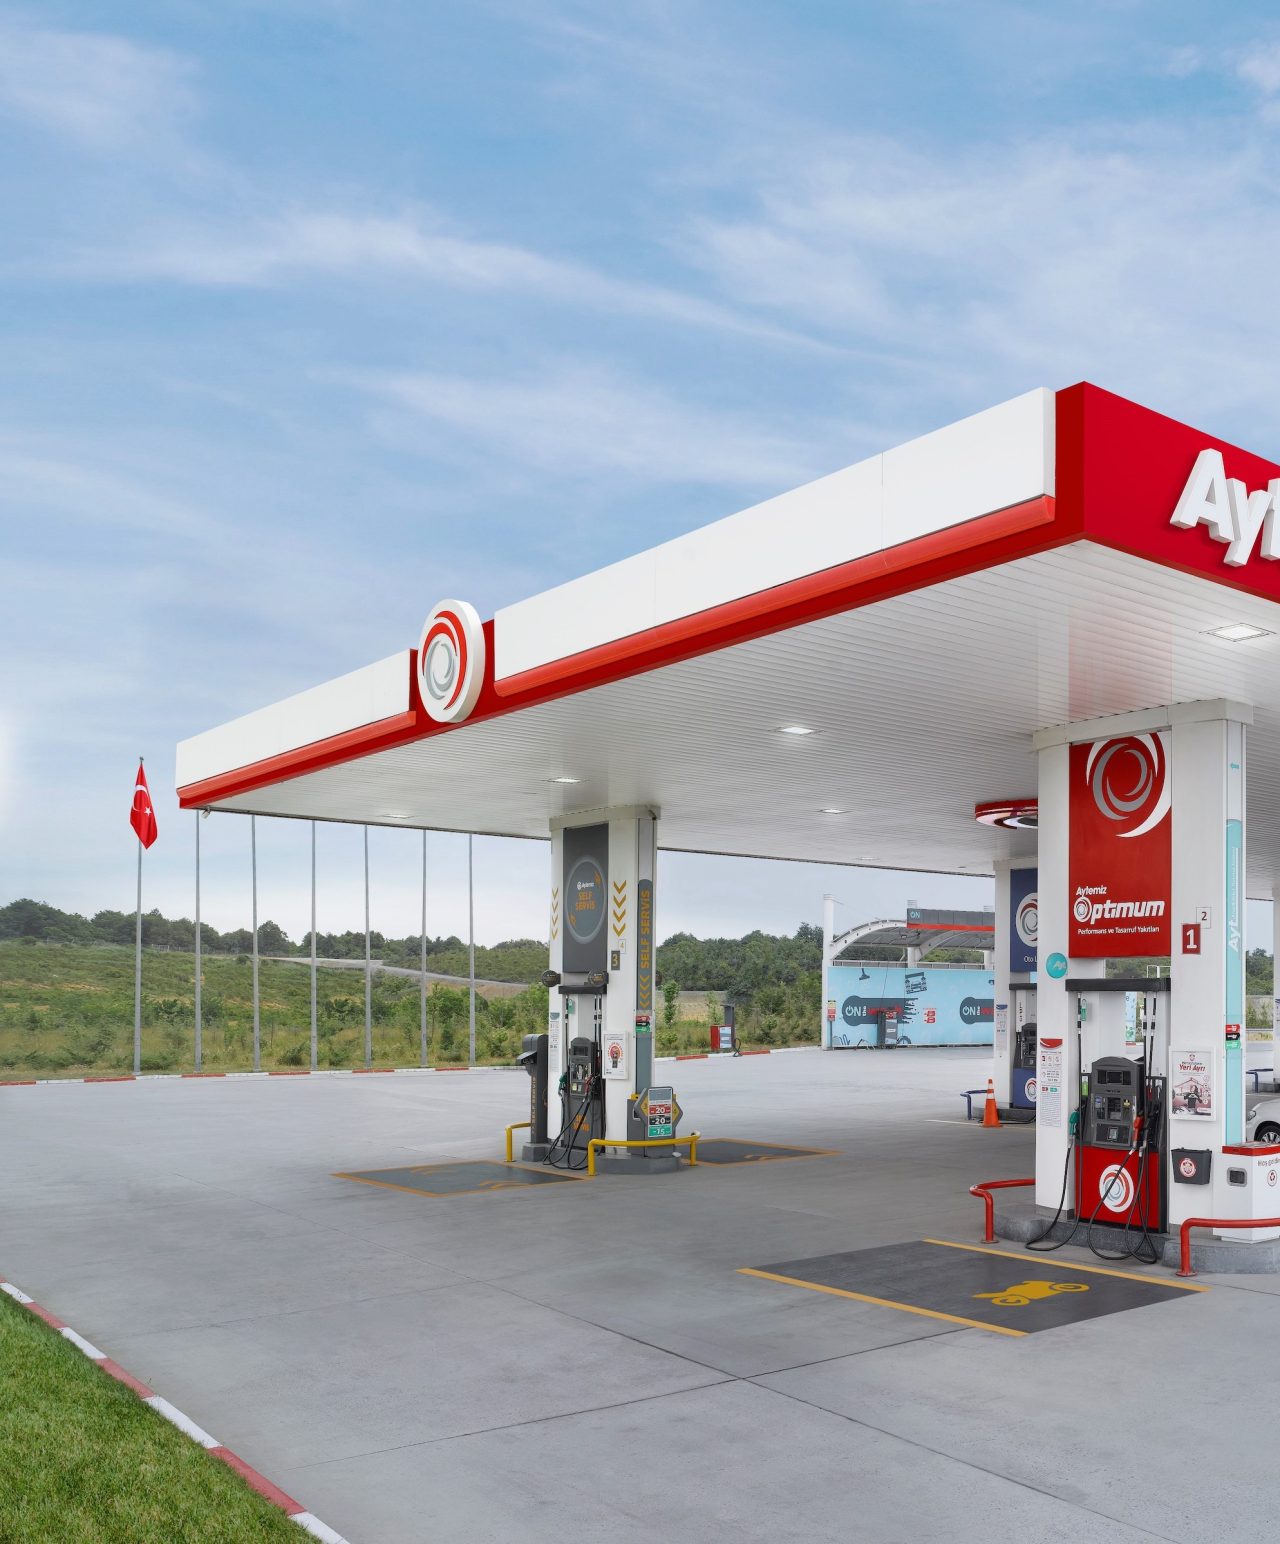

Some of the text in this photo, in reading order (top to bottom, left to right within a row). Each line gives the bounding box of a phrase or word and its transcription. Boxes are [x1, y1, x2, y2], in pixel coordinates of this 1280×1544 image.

[578, 891, 593, 900] SELF
[1076, 885, 1107, 897] Aytemiz
[910, 911, 920, 919] ON
[1201, 911, 1208, 921] 2
[1115, 926, 1137, 934] Tasarruf
[1186, 928, 1198, 949] 1
[640, 938, 650, 969] SELF
[612, 954, 618, 966] 3
[845, 1005, 861, 1017] ON
[962, 1005, 976, 1016] ON
